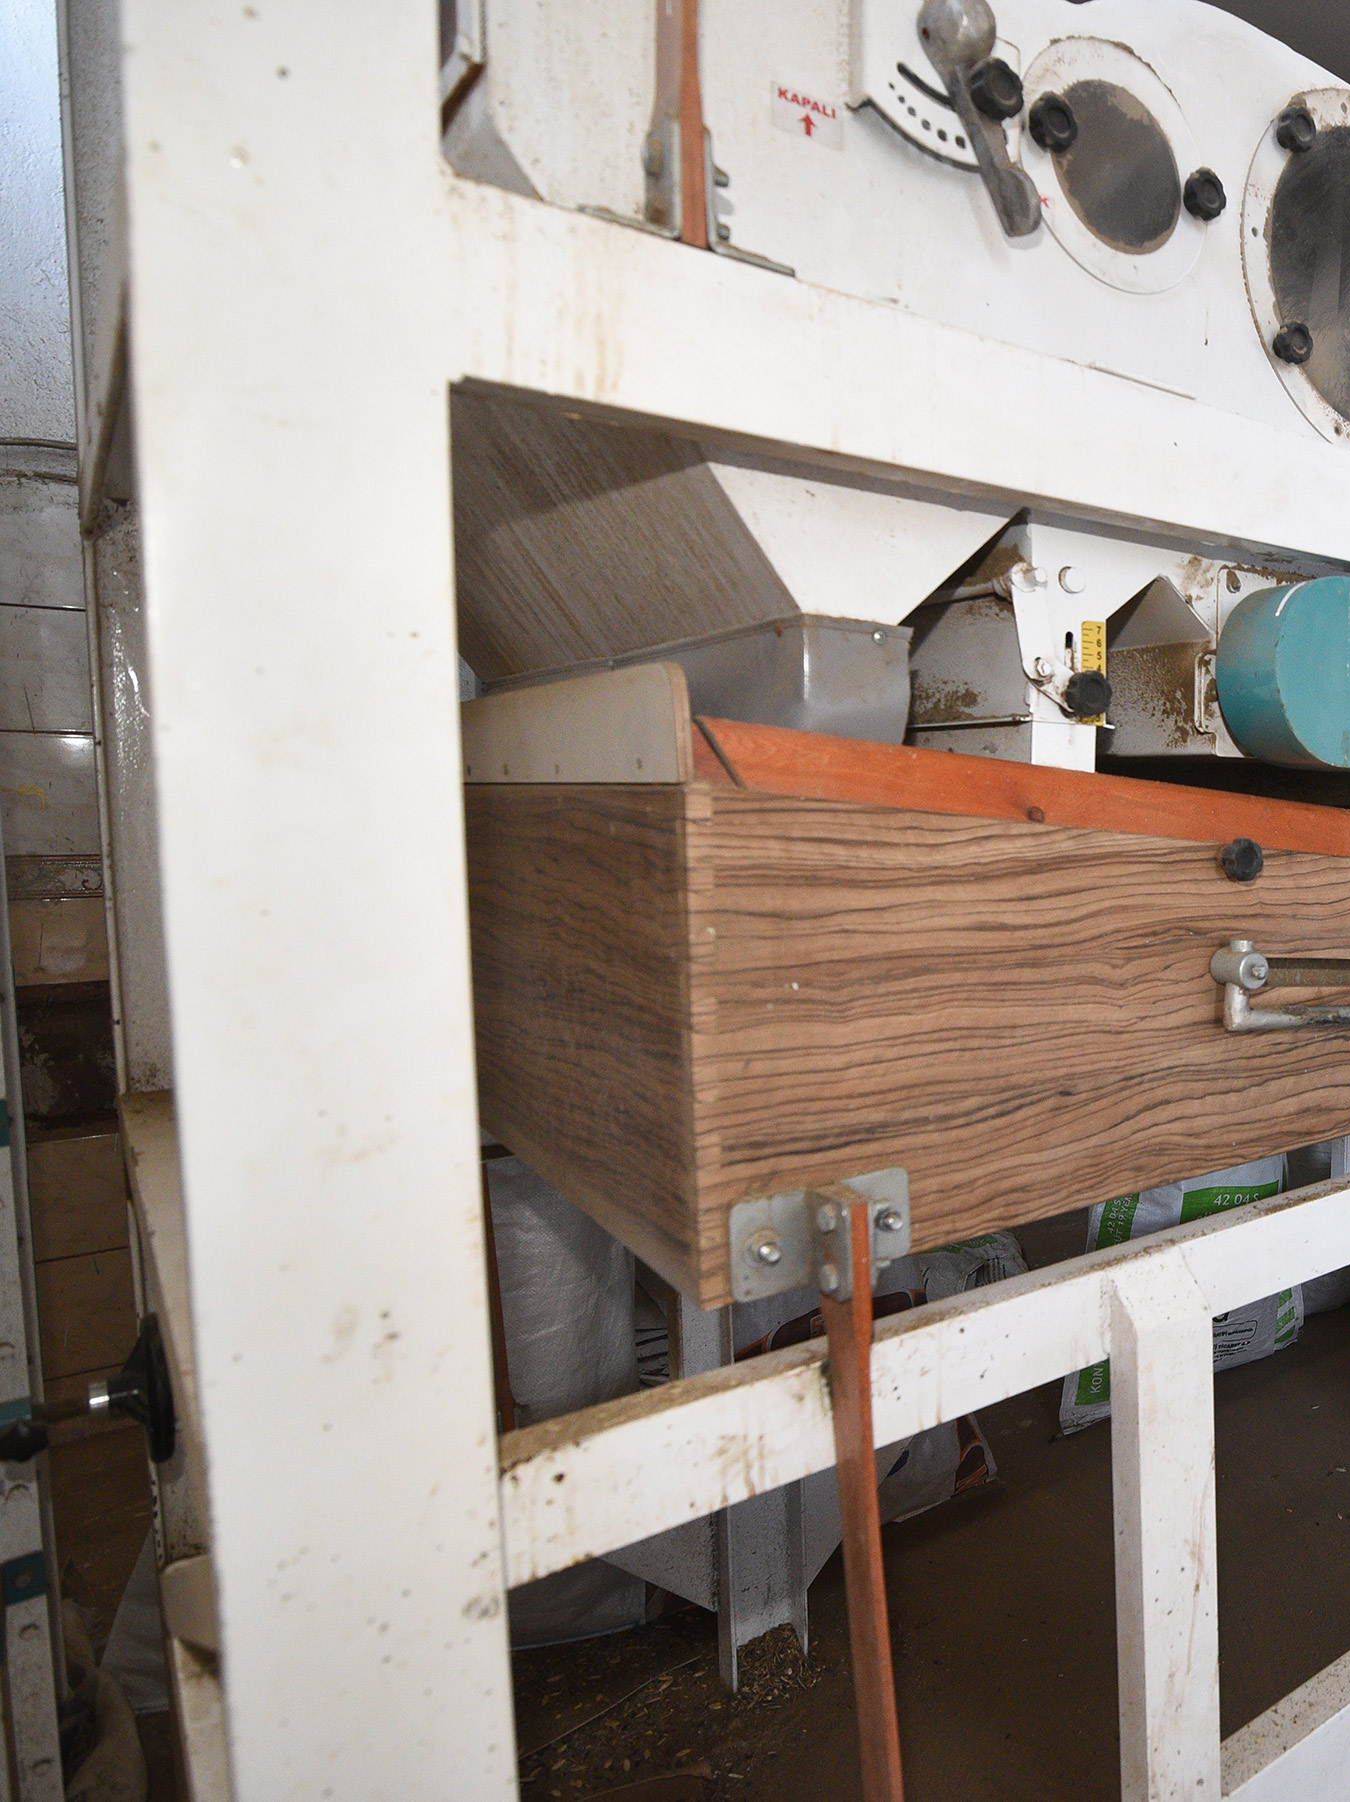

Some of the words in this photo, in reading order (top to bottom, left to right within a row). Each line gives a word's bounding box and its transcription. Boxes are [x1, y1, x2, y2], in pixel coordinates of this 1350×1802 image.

[777, 86, 836, 119] KAPALI
[1096, 625, 1103, 635] 7
[1096, 638, 1102, 648] 6
[1096, 651, 1102, 661] 5
[1213, 1193, 1230, 1206] 42
[1234, 1193, 1250, 1205] 04
[1090, 1362, 1104, 1394] KON
